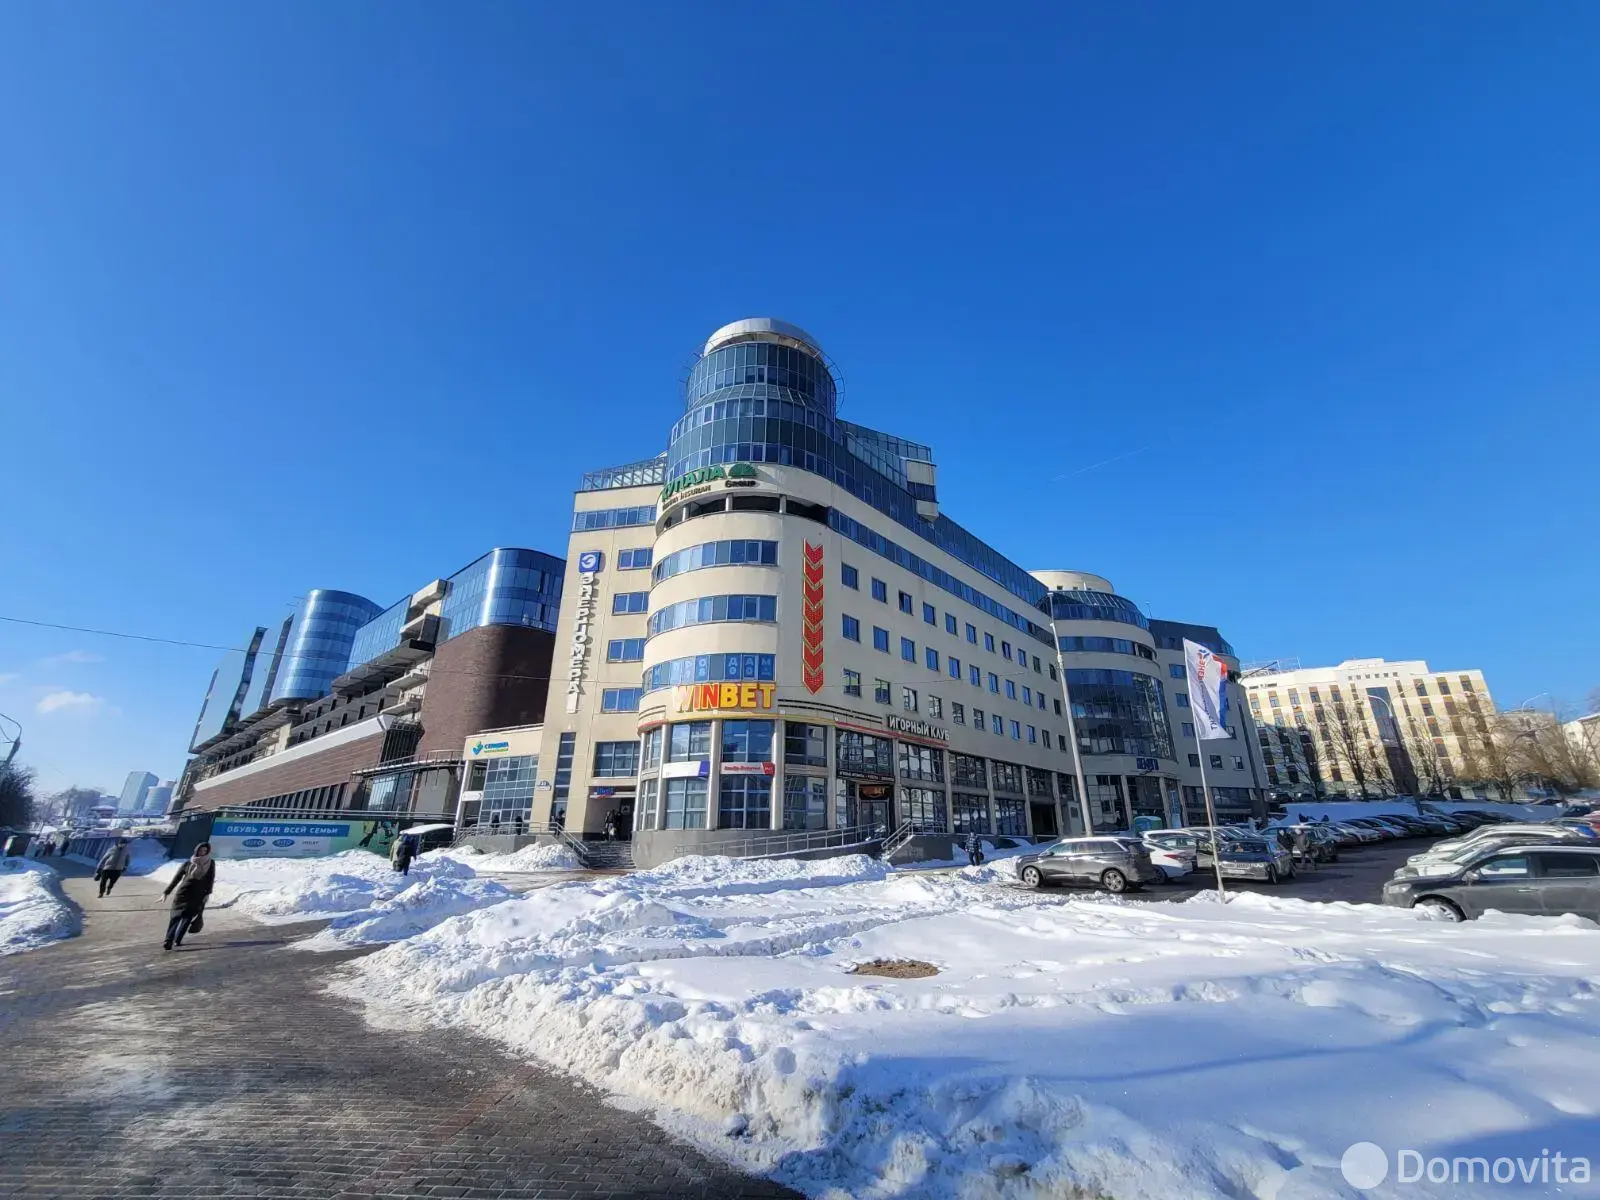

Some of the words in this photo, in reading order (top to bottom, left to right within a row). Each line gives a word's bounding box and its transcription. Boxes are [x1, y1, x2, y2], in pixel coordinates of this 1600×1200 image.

[672, 683, 776, 711] WINBET
[889, 715, 930, 737] ИГОРНЫЙ
[931, 725, 950, 741] КЛУБ
[227, 825, 257, 833] ОБУВЬ
[261, 826, 280, 834] ДЛЯ
